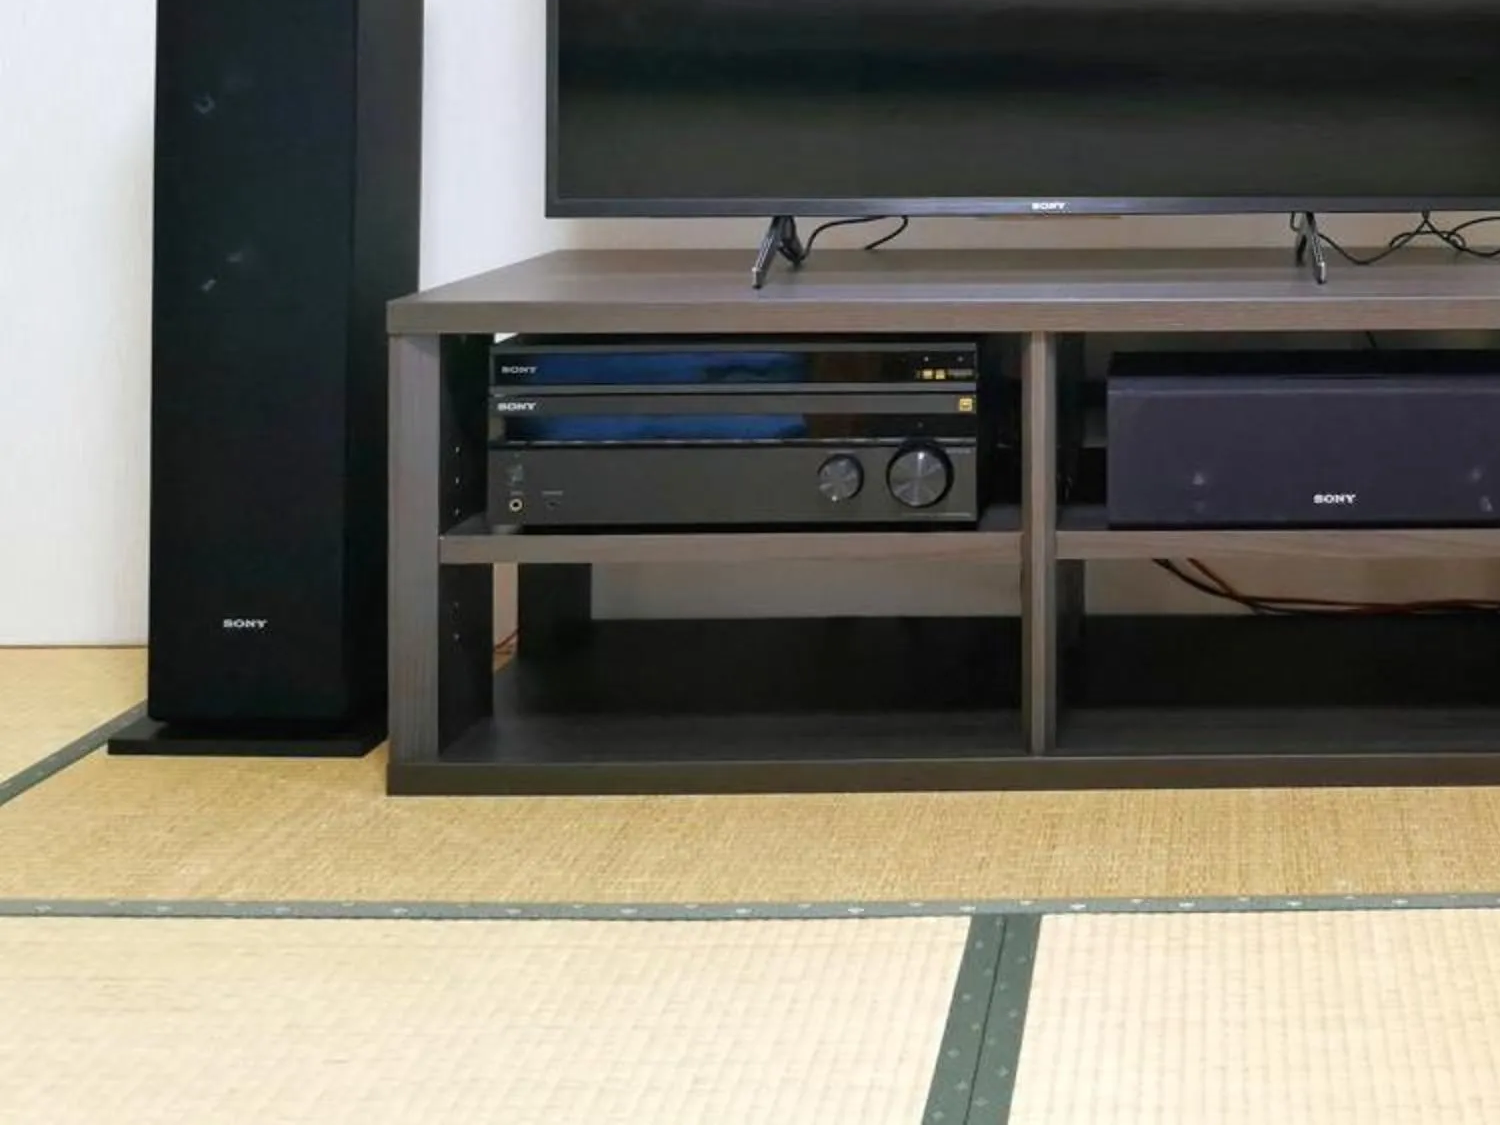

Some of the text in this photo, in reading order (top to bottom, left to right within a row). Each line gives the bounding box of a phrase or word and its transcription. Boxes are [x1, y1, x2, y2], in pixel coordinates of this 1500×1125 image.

[1031, 202, 1066, 211] SONY
[501, 366, 538, 375] SONY
[497, 402, 537, 412] SONY
[1313, 494, 1357, 505] SONY
[223, 618, 269, 629] SONY
